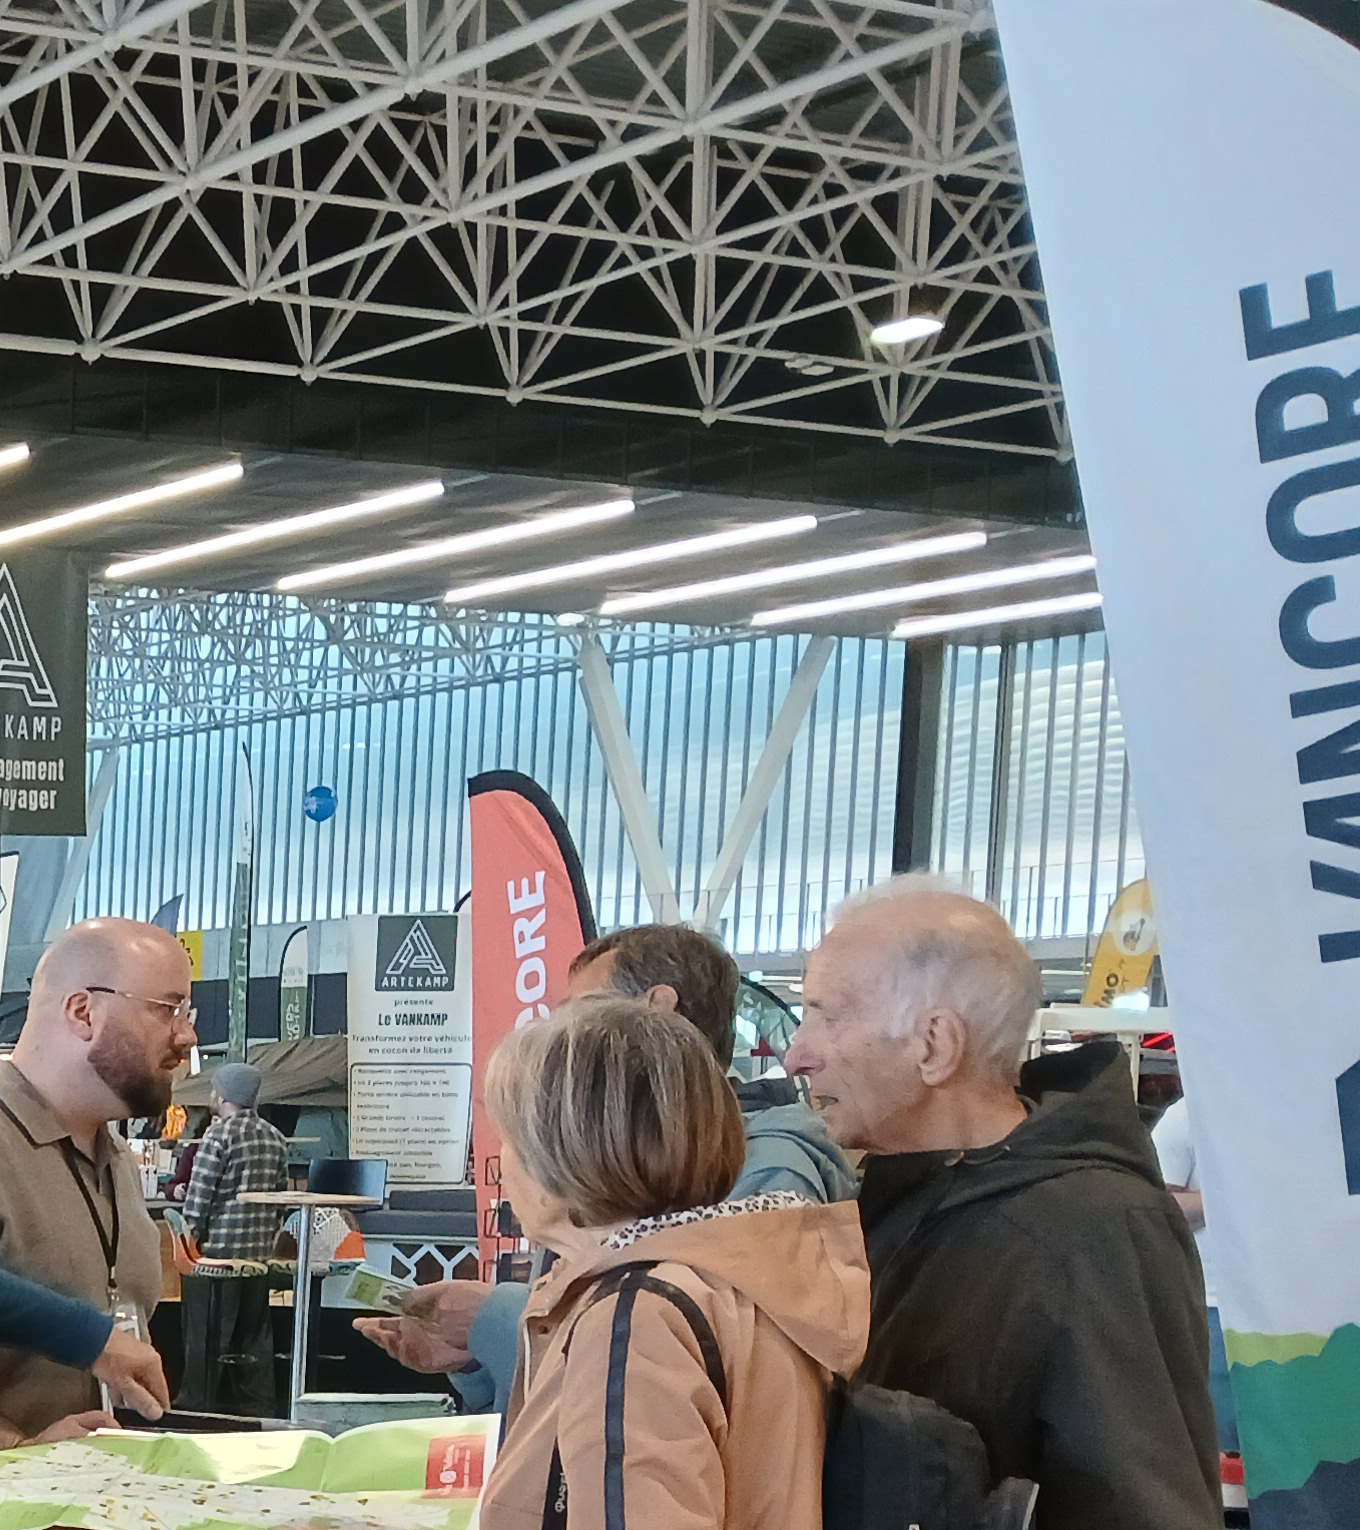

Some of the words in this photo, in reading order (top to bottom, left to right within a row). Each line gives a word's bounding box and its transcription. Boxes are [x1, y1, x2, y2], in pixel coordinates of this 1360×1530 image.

[381, 976, 449, 988] ARTEKAMP
[379, 1013, 391, 1026] Le
[395, 1012, 448, 1026] VANKAMP
